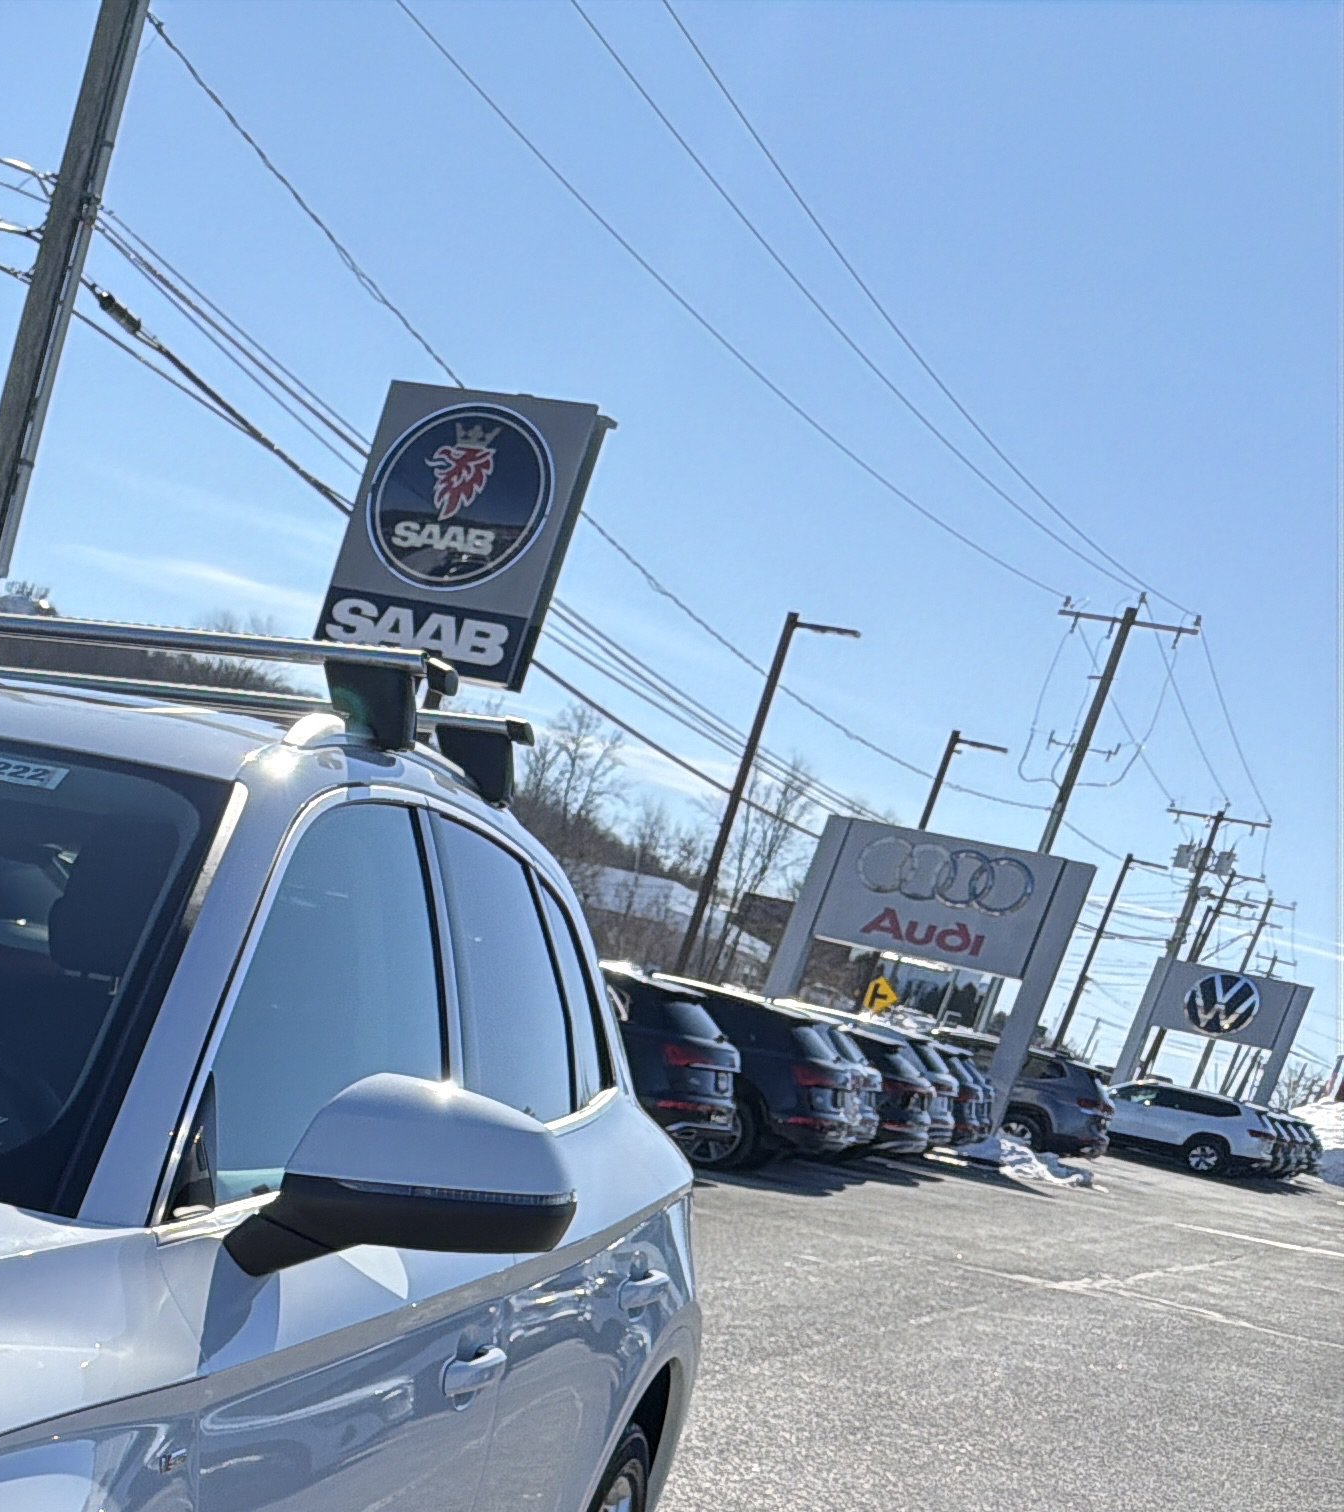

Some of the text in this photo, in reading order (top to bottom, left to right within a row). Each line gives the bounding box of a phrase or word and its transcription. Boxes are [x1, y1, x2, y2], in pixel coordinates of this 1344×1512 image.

[391, 521, 496, 556] SAAB
[325, 598, 510, 667] SAAB
[859, 906, 986, 957] Audi
